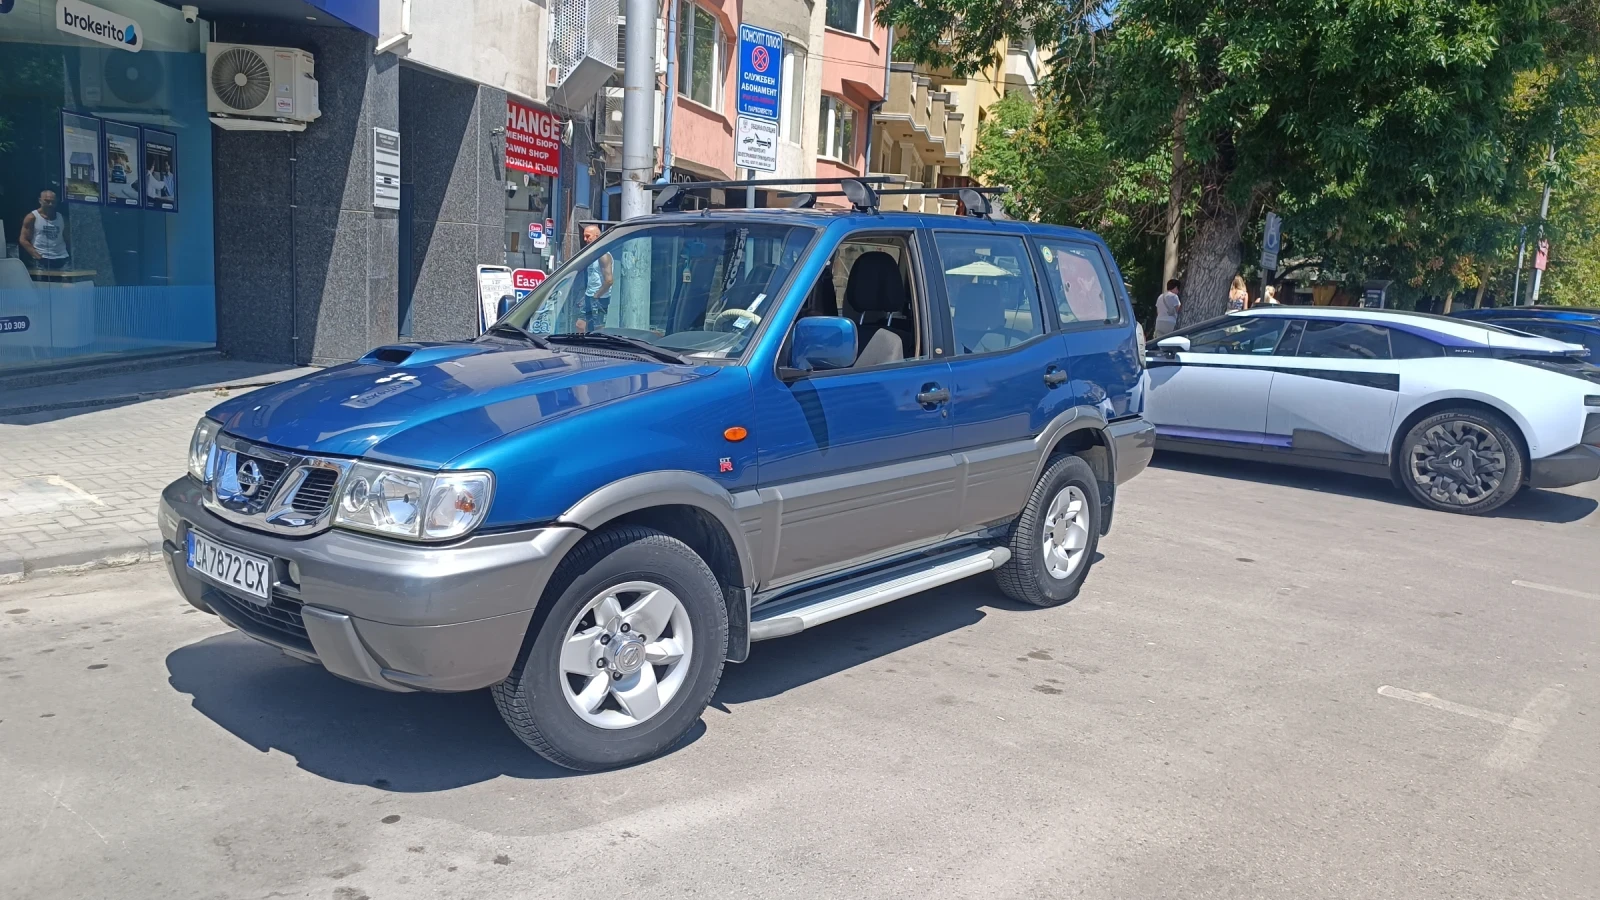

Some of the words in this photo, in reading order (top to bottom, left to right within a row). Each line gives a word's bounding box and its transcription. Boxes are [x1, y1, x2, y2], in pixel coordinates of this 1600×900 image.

[64, 7, 124, 42] brokerito
[742, 28, 765, 45] КОНСУЛТ
[744, 72, 775, 85] СЛУЖЕБЕН
[741, 82, 777, 96] АБОНАМЕНТ
[744, 103, 747, 111] 1
[536, 139, 558, 150] БЮРО
[529, 149, 549, 160] SHOP
[535, 163, 558, 174] КЪЩА
[516, 275, 541, 287] Easy
[14, 322, 26, 330] 309
[196, 539, 265, 594] CA7872CX
